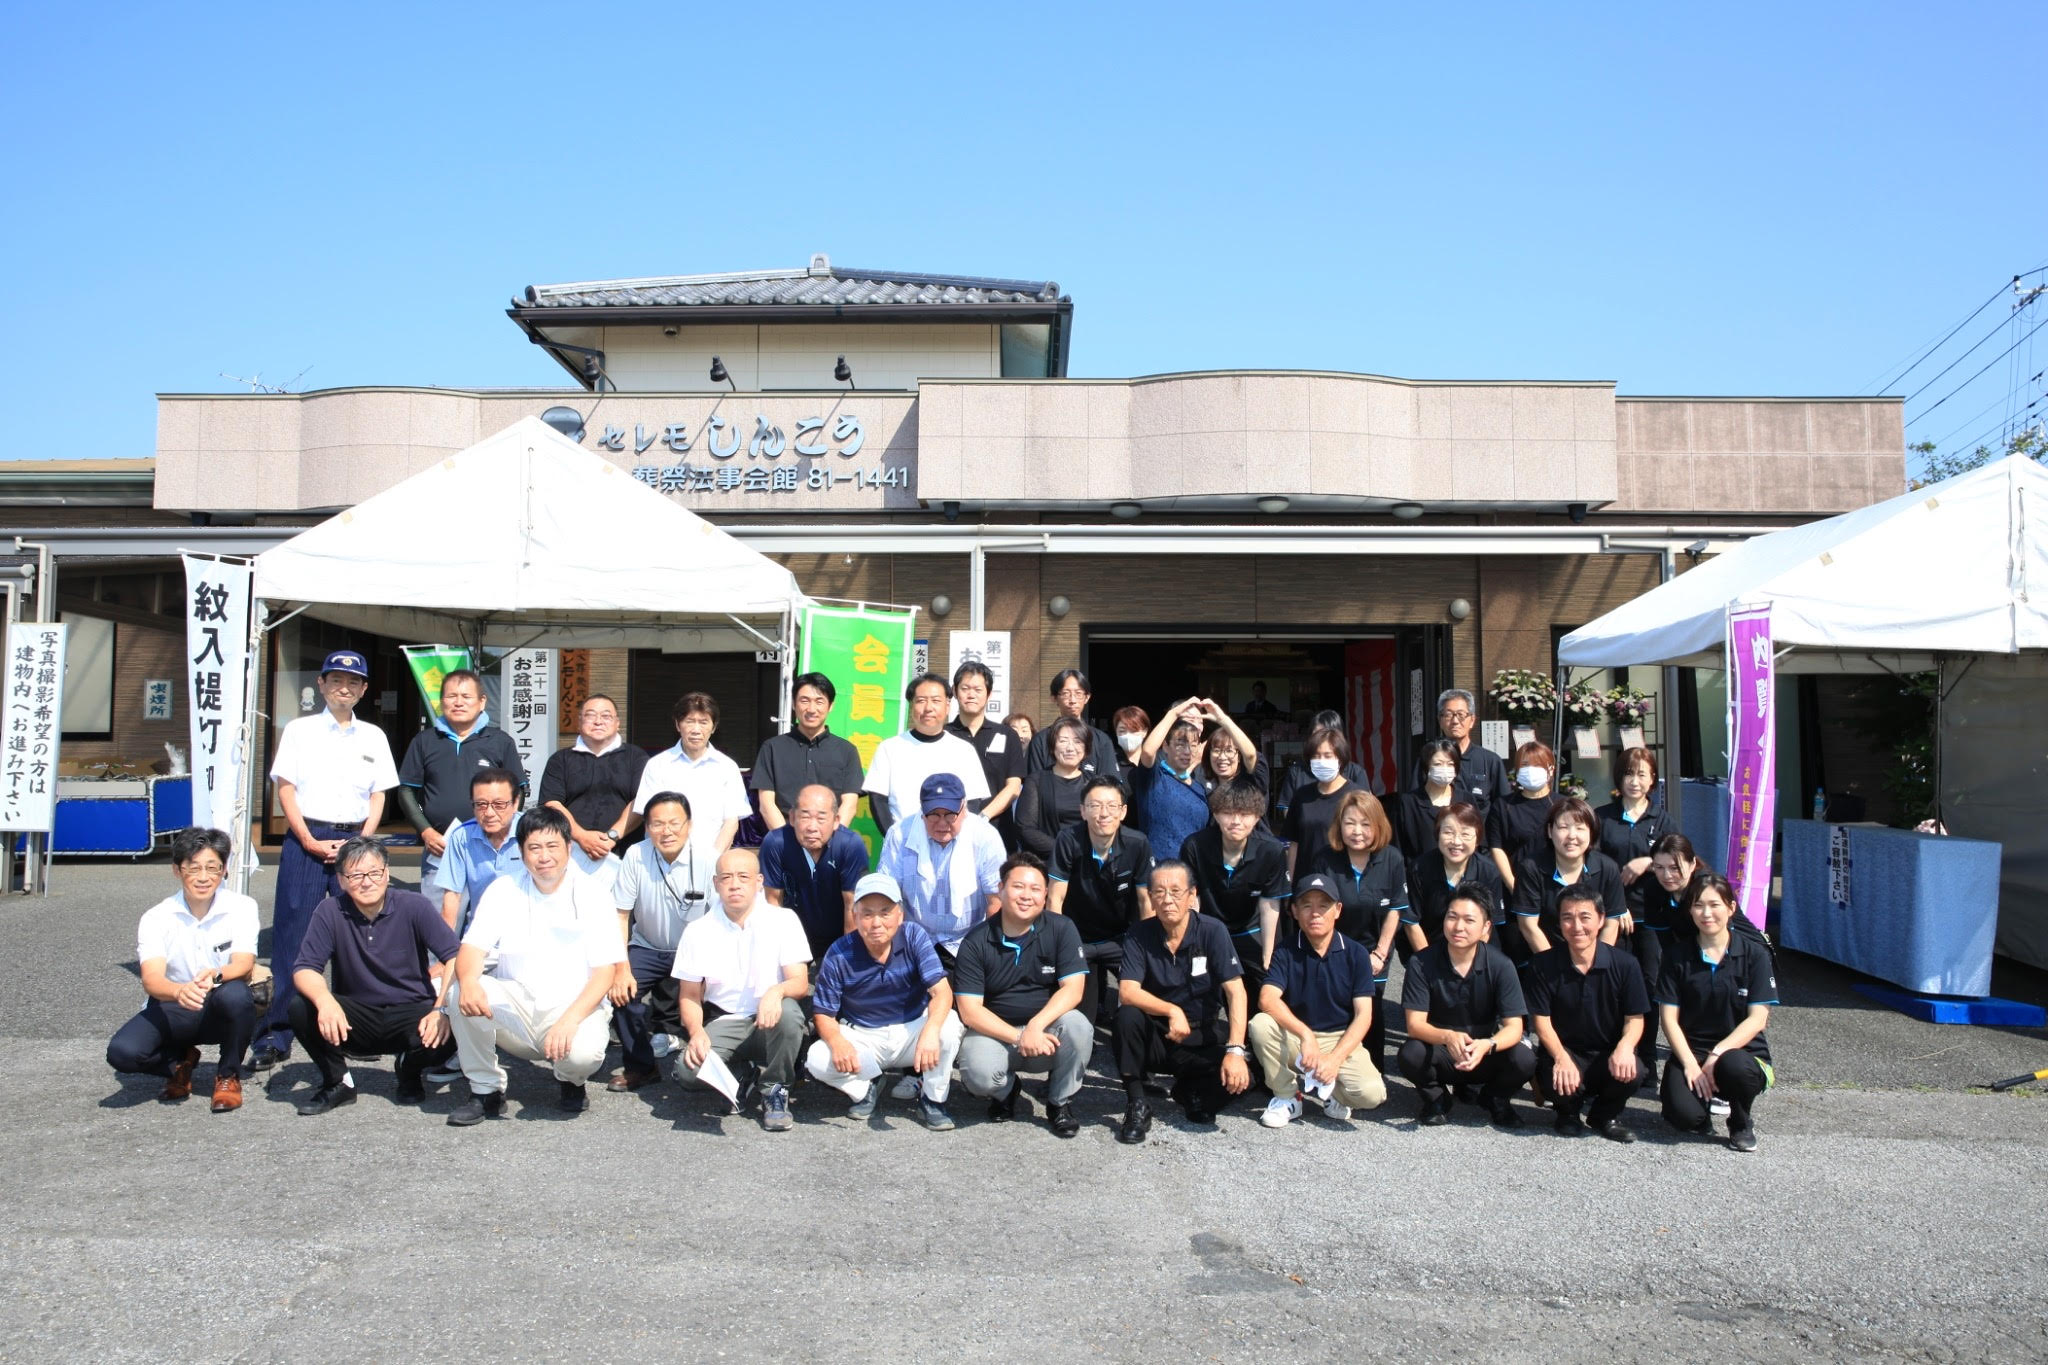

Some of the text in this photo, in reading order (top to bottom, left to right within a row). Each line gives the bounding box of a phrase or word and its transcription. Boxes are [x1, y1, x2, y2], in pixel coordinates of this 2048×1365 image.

[598, 414, 866, 458] セレモしんこう
[807, 466, 910, 490] 81-1441
[150, 683, 167, 717] 喫煙所
[534, 651, 548, 715] 第二十一回
[4, 645, 36, 822] 建物内へお進み下さい
[29, 631, 58, 794] 写真撮影希望の方は
